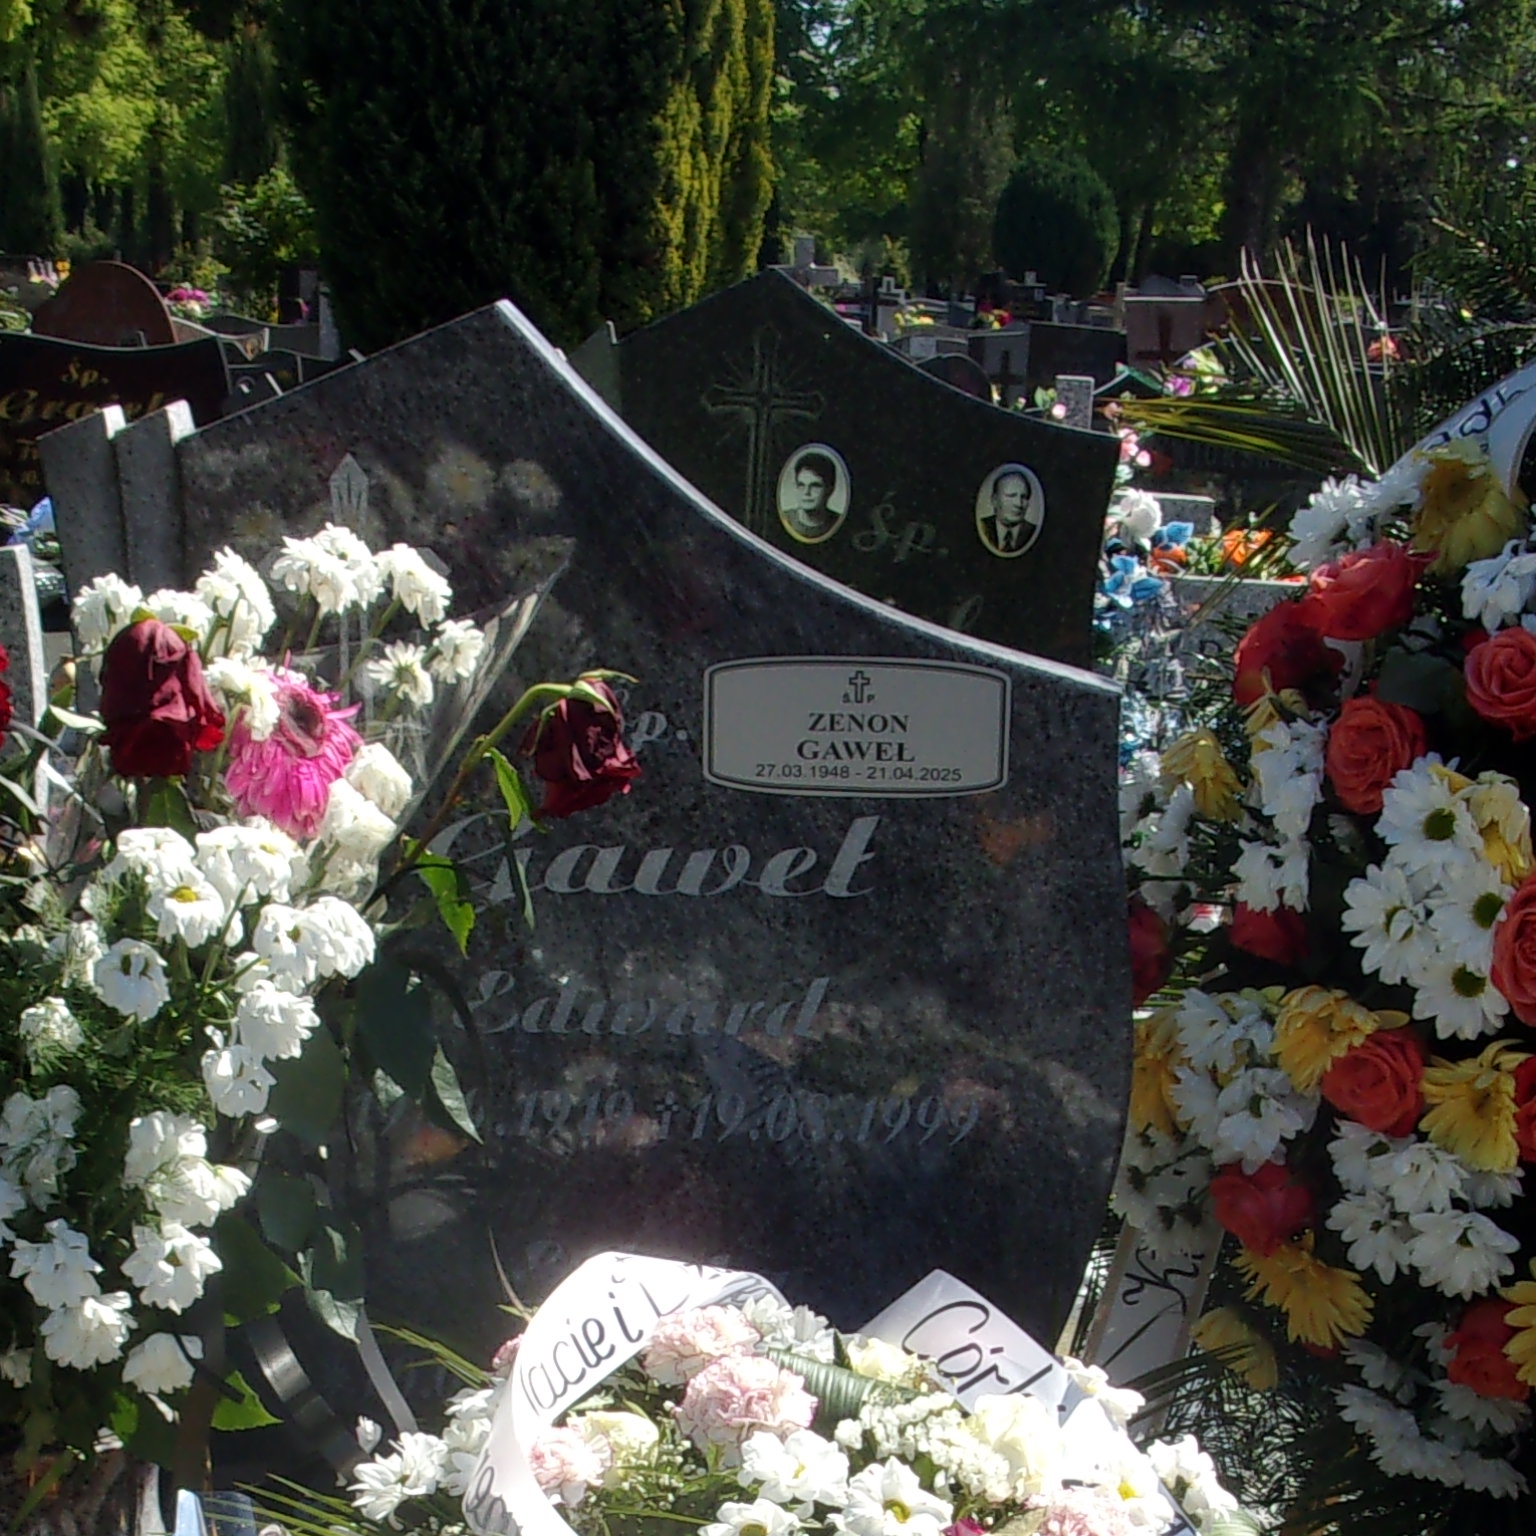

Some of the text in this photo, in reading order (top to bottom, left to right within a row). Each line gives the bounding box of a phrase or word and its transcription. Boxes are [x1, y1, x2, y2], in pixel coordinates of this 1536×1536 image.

[807, 712, 910, 733] ZENON
[755, 763, 850, 780] 27.03.1948
[866, 764, 963, 782] 21.04.2025
[453, 969, 831, 1038] Edward
